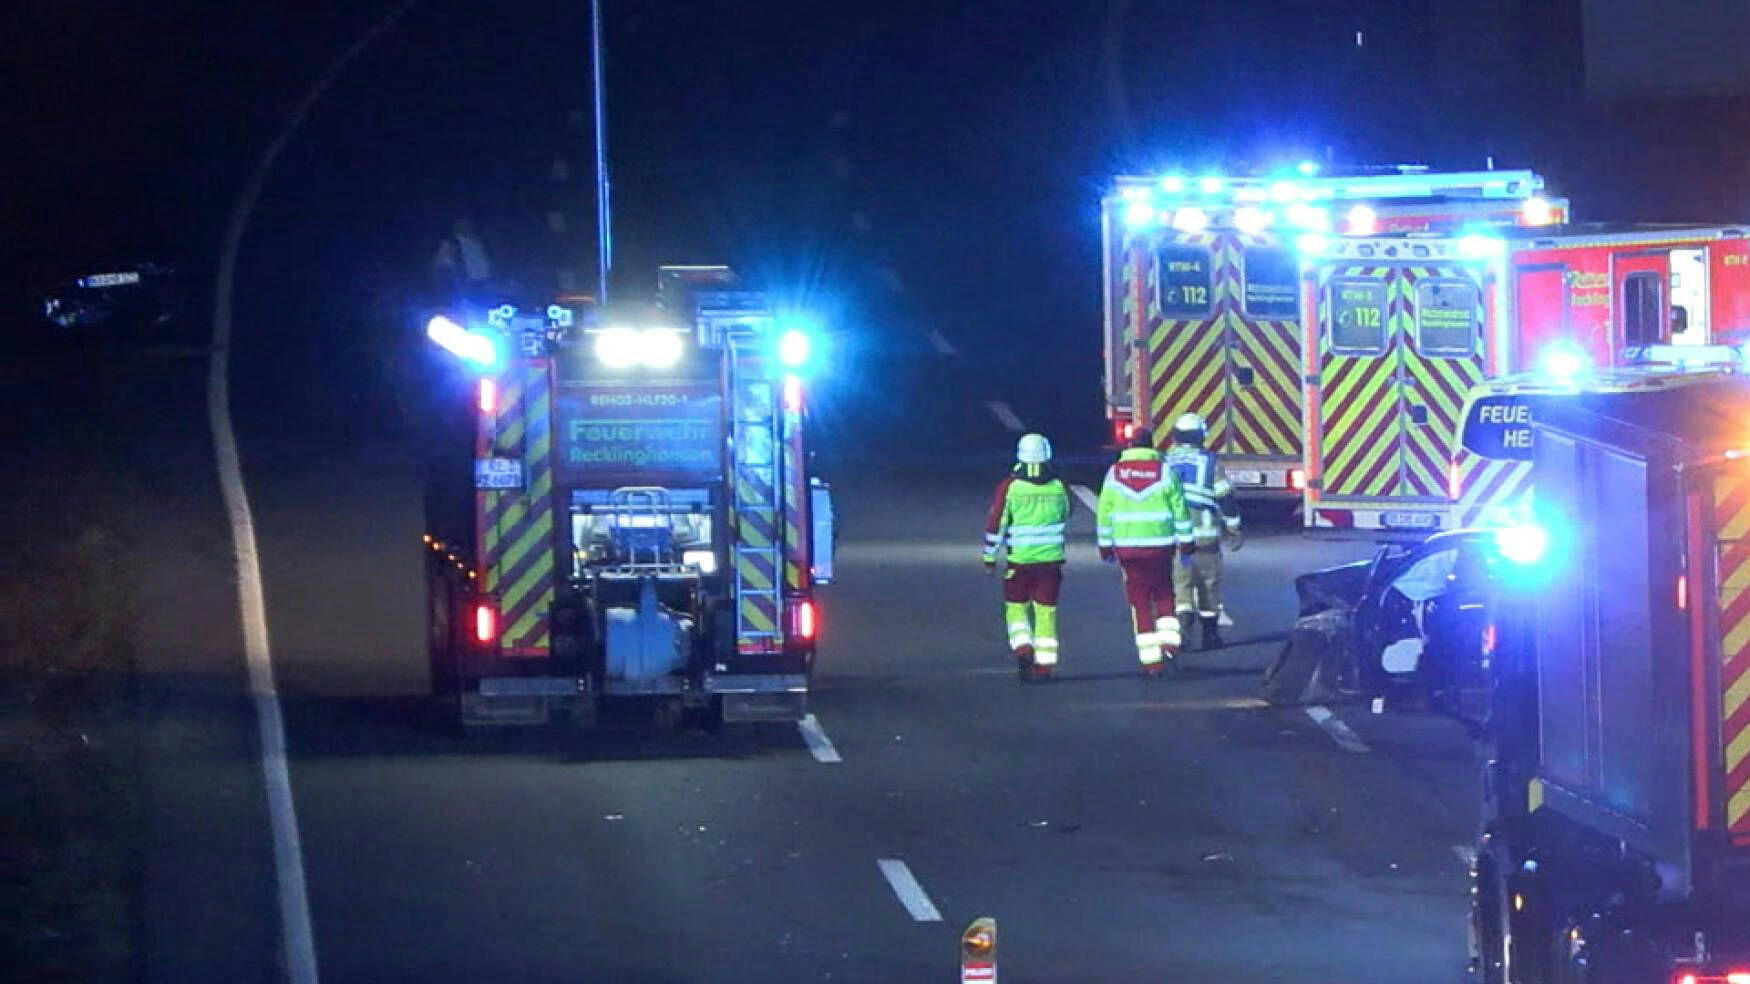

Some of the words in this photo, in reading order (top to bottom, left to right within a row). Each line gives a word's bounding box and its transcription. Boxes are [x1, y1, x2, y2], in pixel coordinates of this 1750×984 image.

[1182, 286, 1207, 304] 112
[1355, 307, 1381, 328] 112
[1480, 405, 1531, 424] FEUE
[1503, 429, 1533, 448] HE
